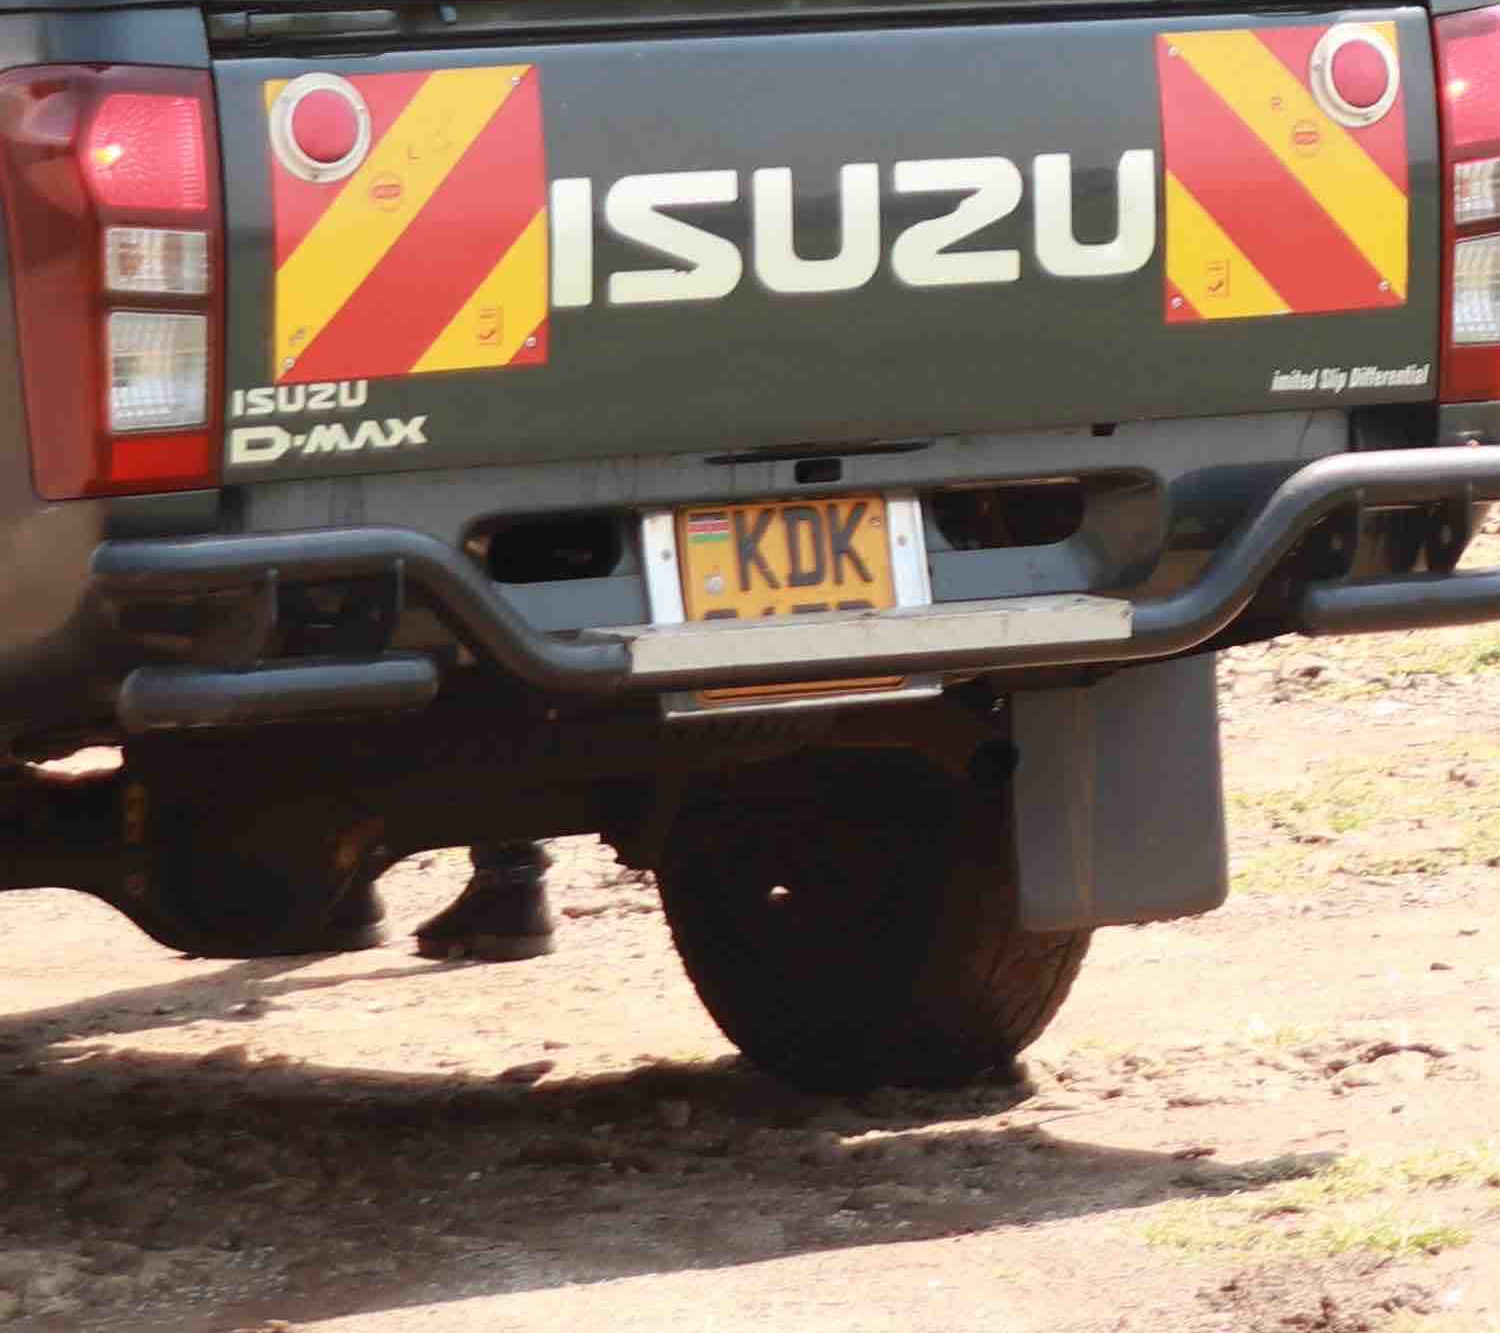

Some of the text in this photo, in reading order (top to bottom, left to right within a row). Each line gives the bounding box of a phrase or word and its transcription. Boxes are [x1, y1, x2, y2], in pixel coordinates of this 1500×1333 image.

[551, 149, 1155, 307] ISUZU
[232, 380, 368, 416] ISUZU
[230, 416, 428, 463] D-MAX
[735, 501, 872, 591] KDK
